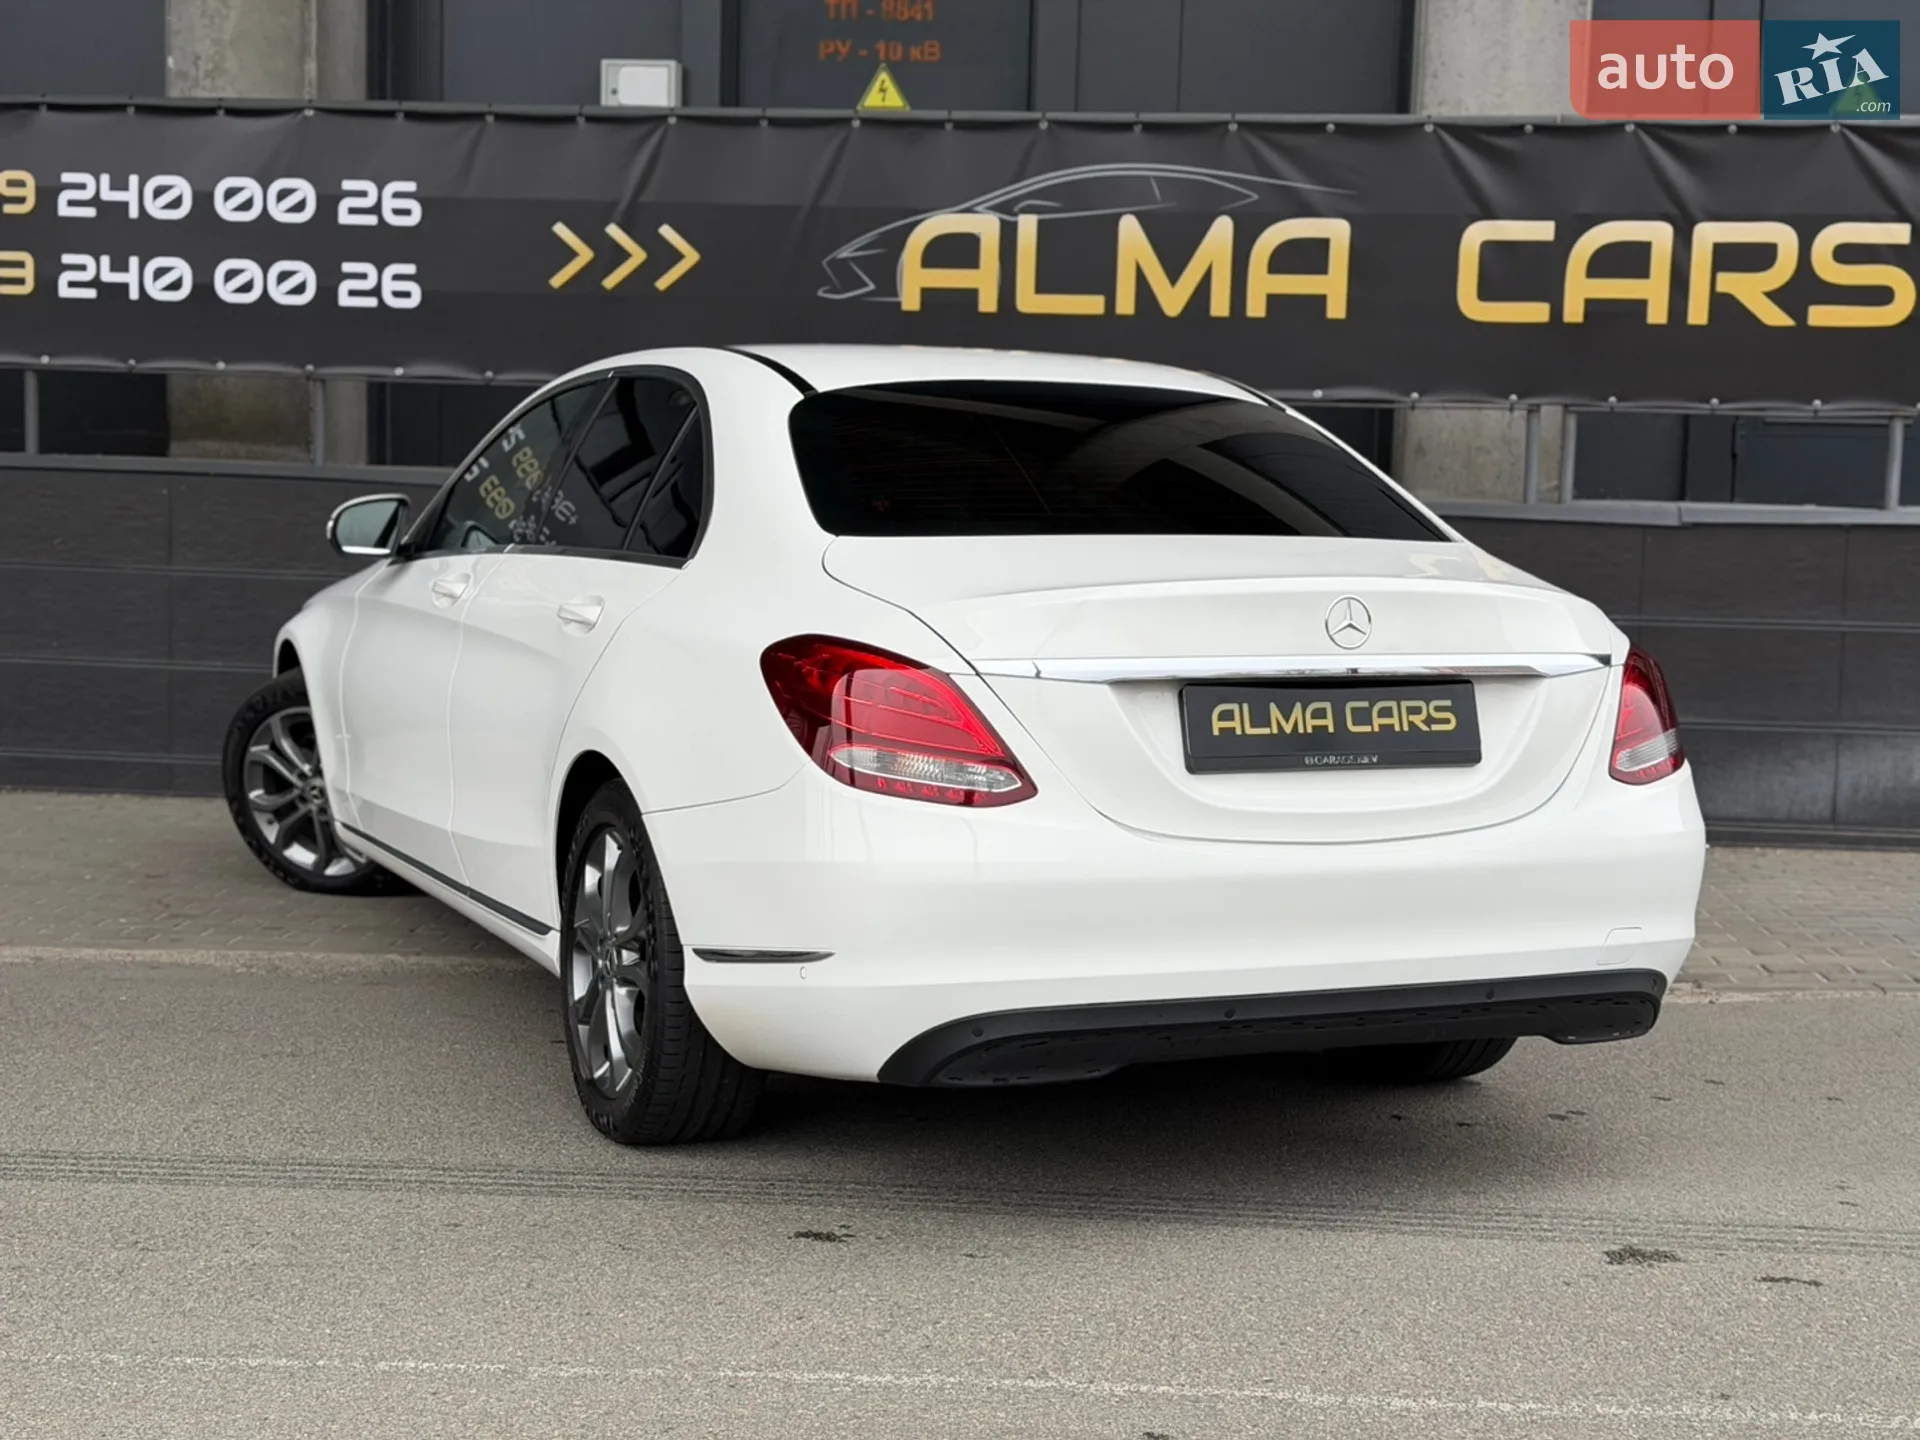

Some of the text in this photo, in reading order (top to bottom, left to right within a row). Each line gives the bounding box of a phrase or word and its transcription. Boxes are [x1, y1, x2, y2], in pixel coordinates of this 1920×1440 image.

[819, 40, 851, 61] РУ
[875, 41, 903, 61] 10
[57, 172, 193, 220] 240
[214, 176, 317, 224] 00
[337, 180, 422, 226] 26
[57, 254, 193, 302] 240
[214, 258, 317, 306] 00
[337, 262, 422, 309] 26
[901, 213, 1917, 328] ALMA CARS
[1211, 700, 1457, 736] ALMA CARS
